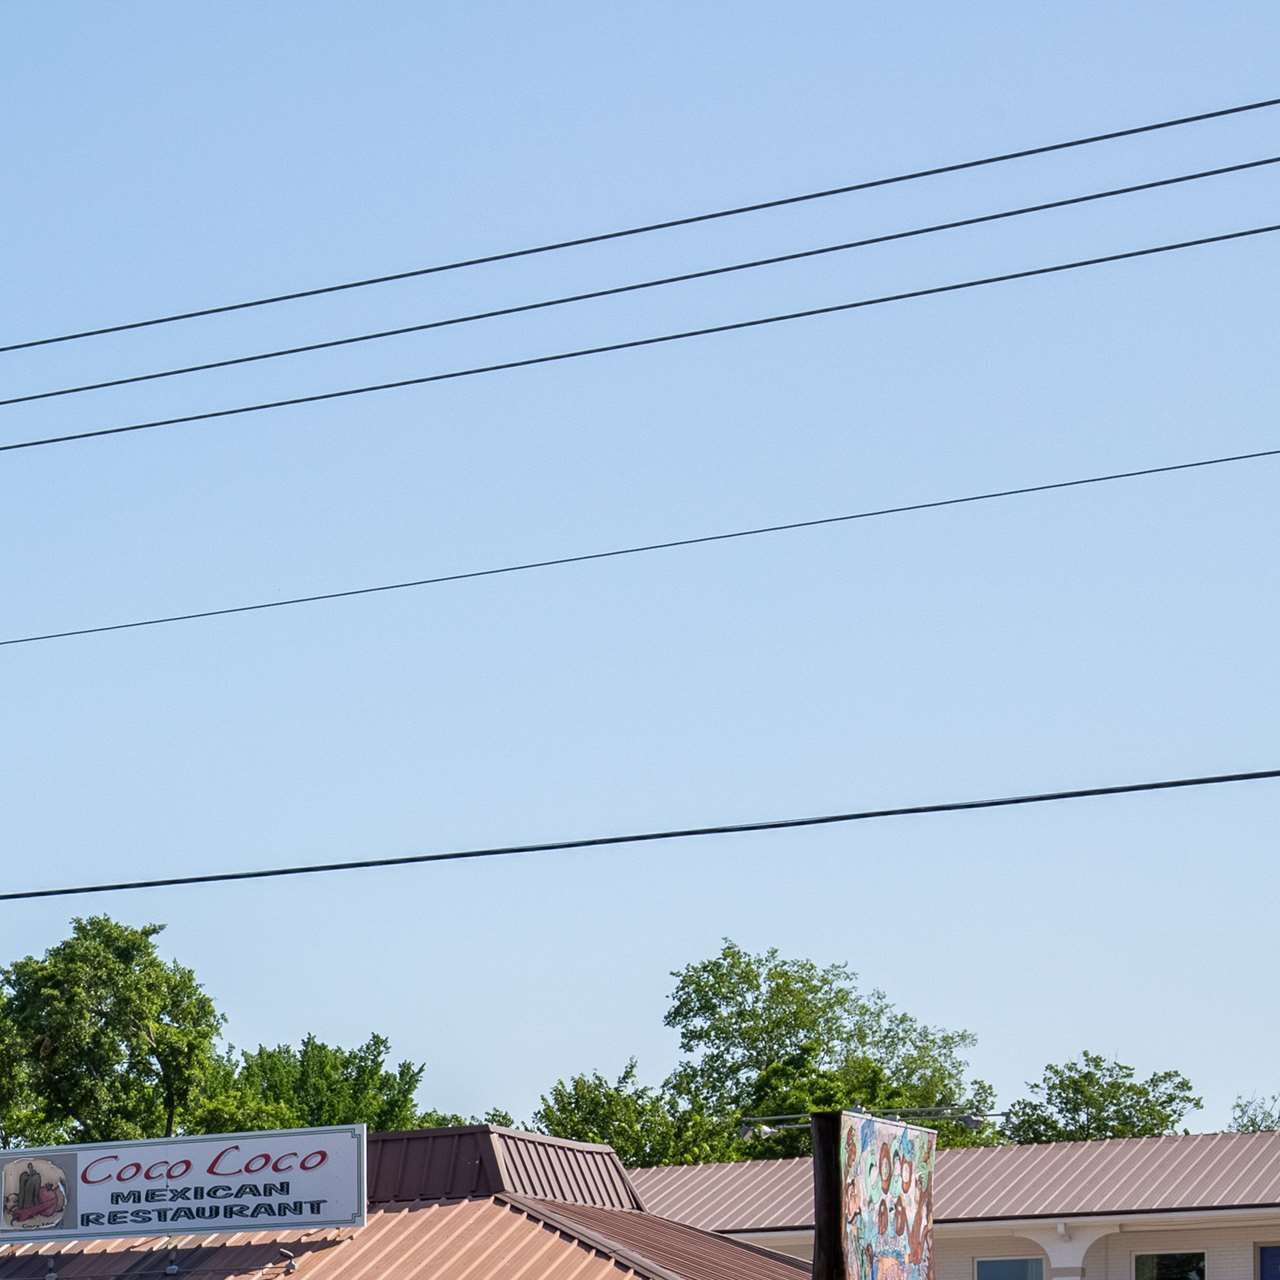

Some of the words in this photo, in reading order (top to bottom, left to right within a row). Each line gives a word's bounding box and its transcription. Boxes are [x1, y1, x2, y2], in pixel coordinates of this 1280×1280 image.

[80, 1155, 193, 1185] Coco
[206, 1145, 329, 1177] Loco
[110, 1181, 291, 1205] MEXICAN
[80, 1199, 328, 1228] RESTAURANT
